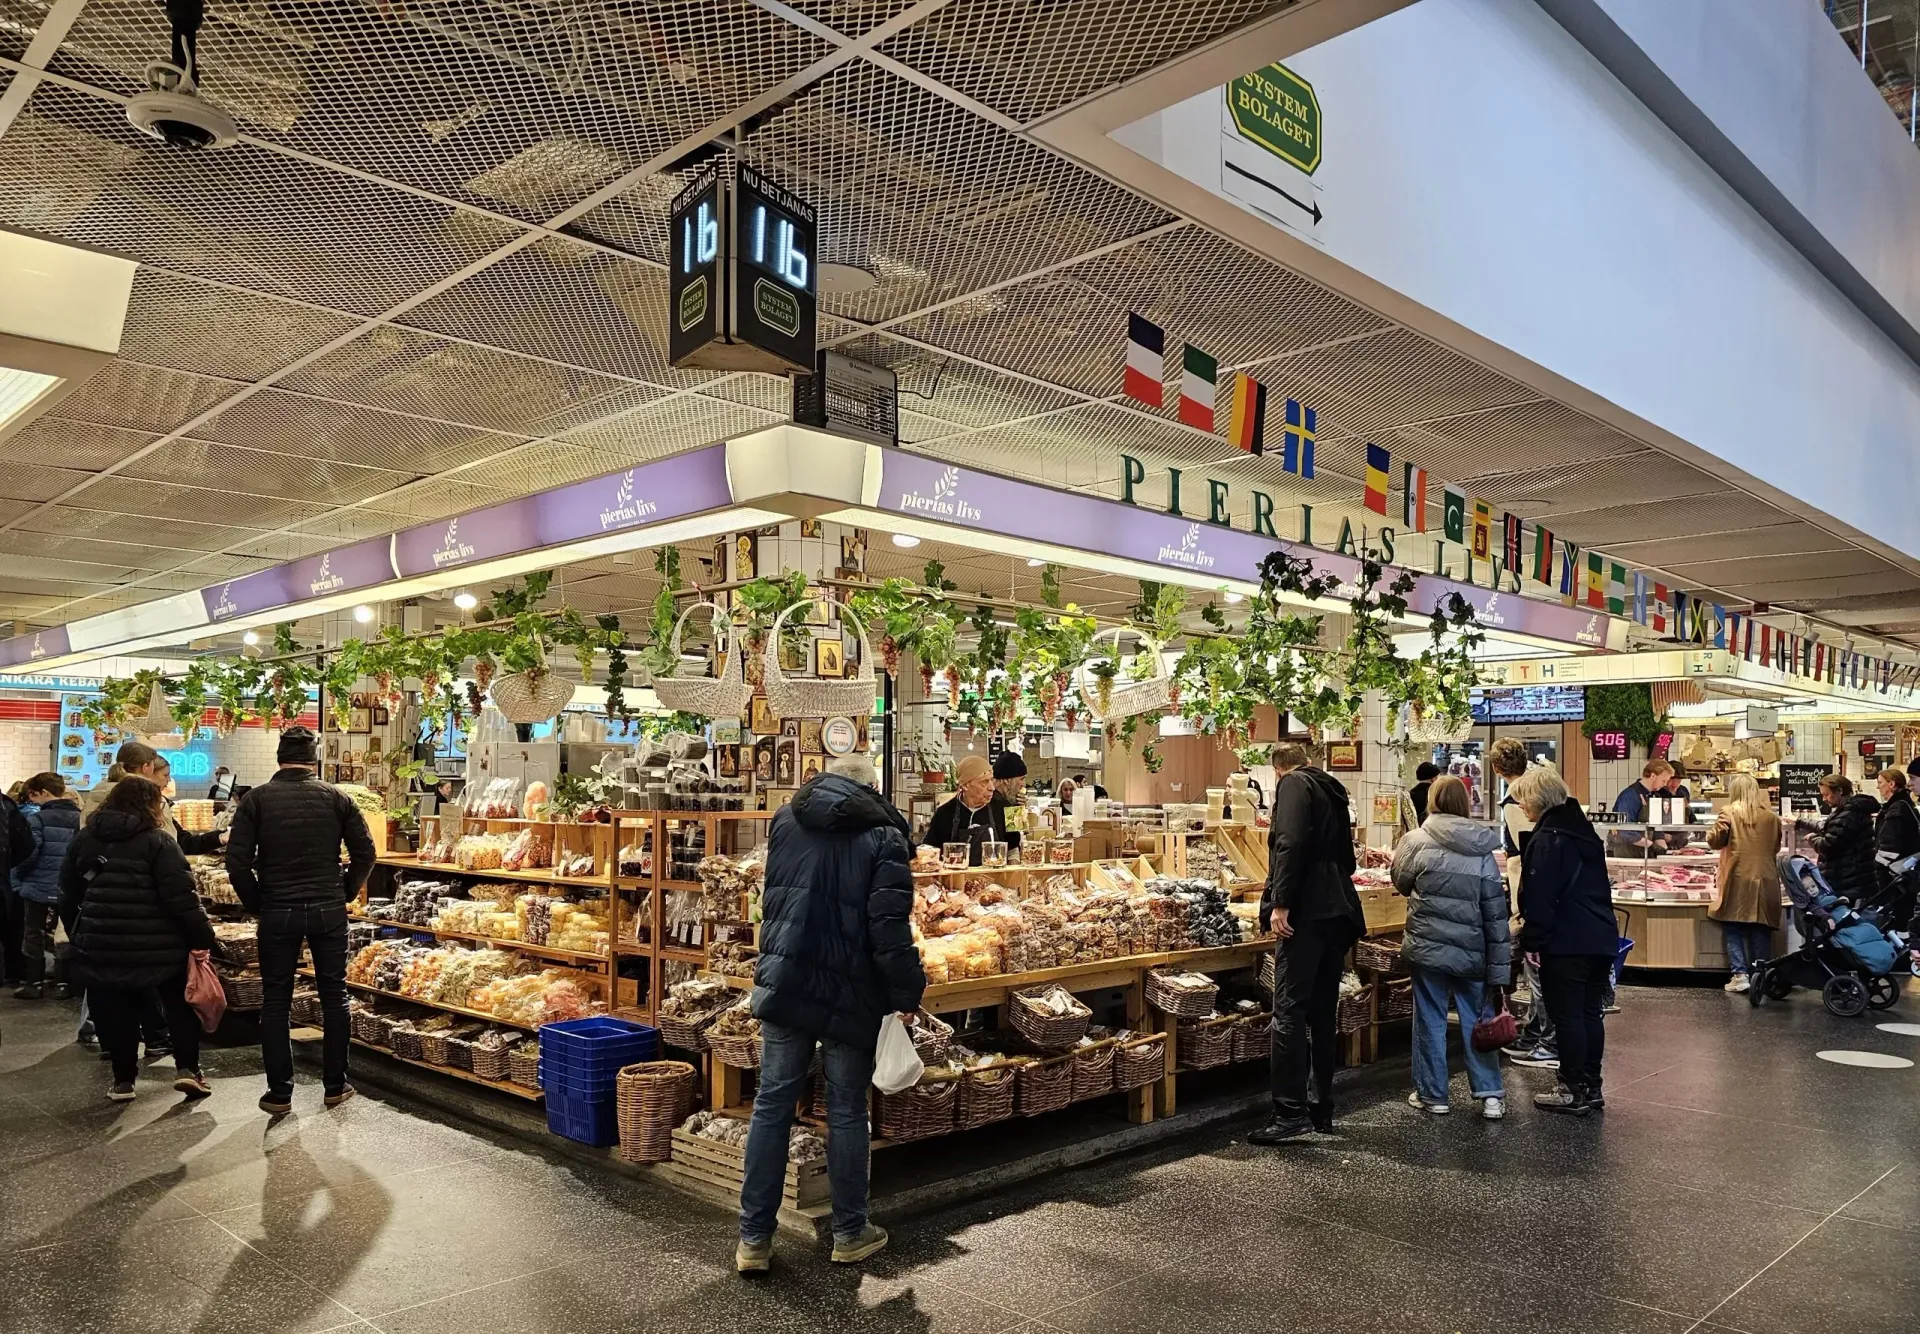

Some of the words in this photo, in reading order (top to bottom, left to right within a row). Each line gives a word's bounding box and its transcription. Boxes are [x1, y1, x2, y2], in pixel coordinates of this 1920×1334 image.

[1242, 72, 1309, 123] SYSTEM
[1238, 88, 1313, 150] BOLAGET
[672, 198, 683, 216] NU
[742, 168, 759, 189] NU
[760, 180, 814, 224] BETJÄNAS
[760, 300, 794, 324] BOLAGET
[762, 291, 792, 313] SYSTEM
[600, 503, 637, 529] pierias
[636, 498, 657, 518] livs
[899, 490, 955, 516] pierias
[956, 499, 982, 521] livs
[1120, 453, 1396, 564] PIERIAS
[432, 548, 460, 568] pierias
[458, 542, 475, 558] livs
[1157, 543, 1196, 563] pierias
[1197, 550, 1215, 567] livs
[0, 674, 55, 686] NKARA
[1595, 733, 1625, 746] 506
